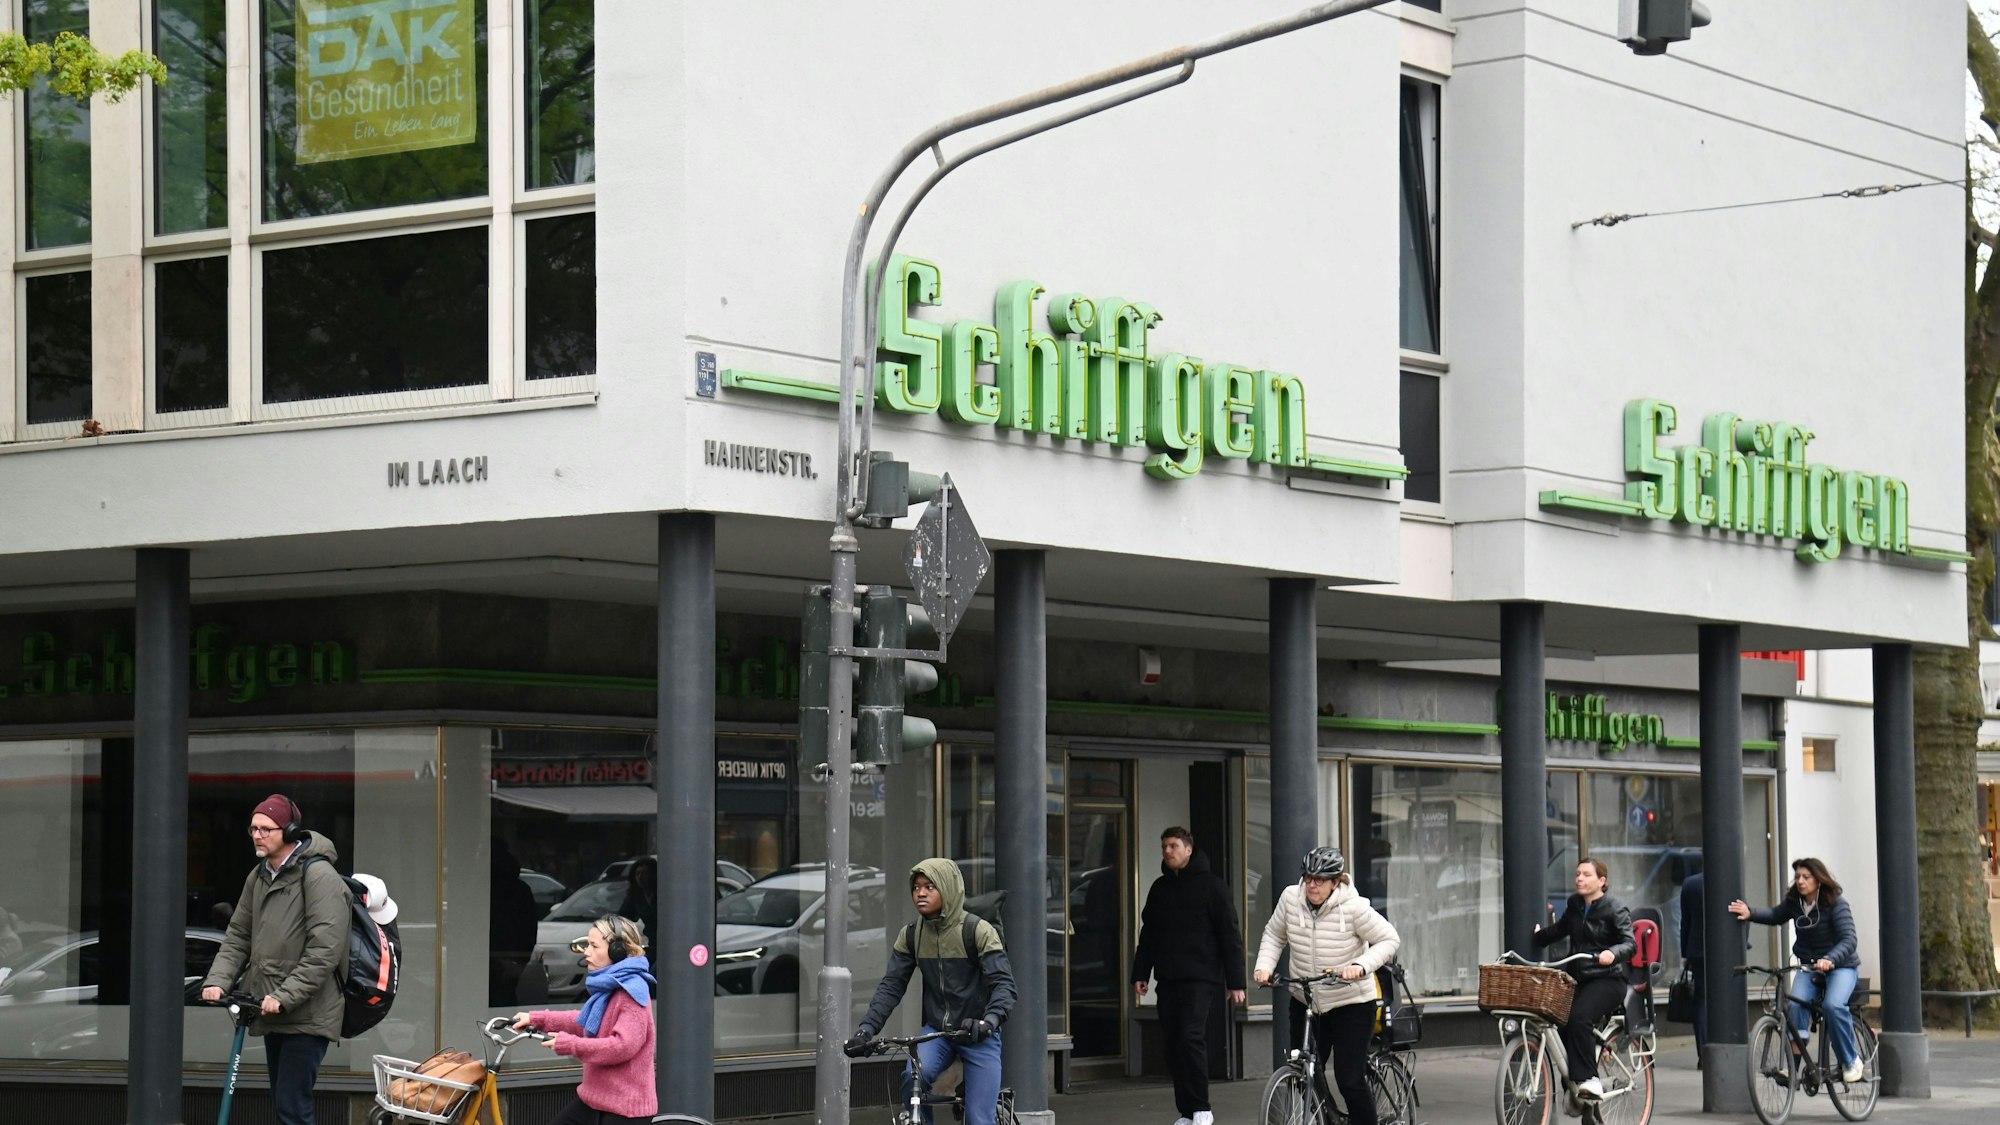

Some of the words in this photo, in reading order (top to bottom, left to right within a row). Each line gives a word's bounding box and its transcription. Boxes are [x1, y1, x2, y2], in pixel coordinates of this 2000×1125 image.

[307, 0, 461, 77] DAK
[308, 64, 464, 120] Gesundheit
[354, 120, 378, 140] Ein
[384, 113, 424, 137] Leben
[868, 253, 1307, 481] Schiffgen
[387, 461, 410, 487] IM
[418, 456, 489, 485] LAACH
[704, 439, 819, 480] HAHNENSTR.
[1624, 398, 1909, 563] Schiffgen
[21, 621, 353, 704] Schfgen
[1545, 690, 1665, 753] hiffgen
